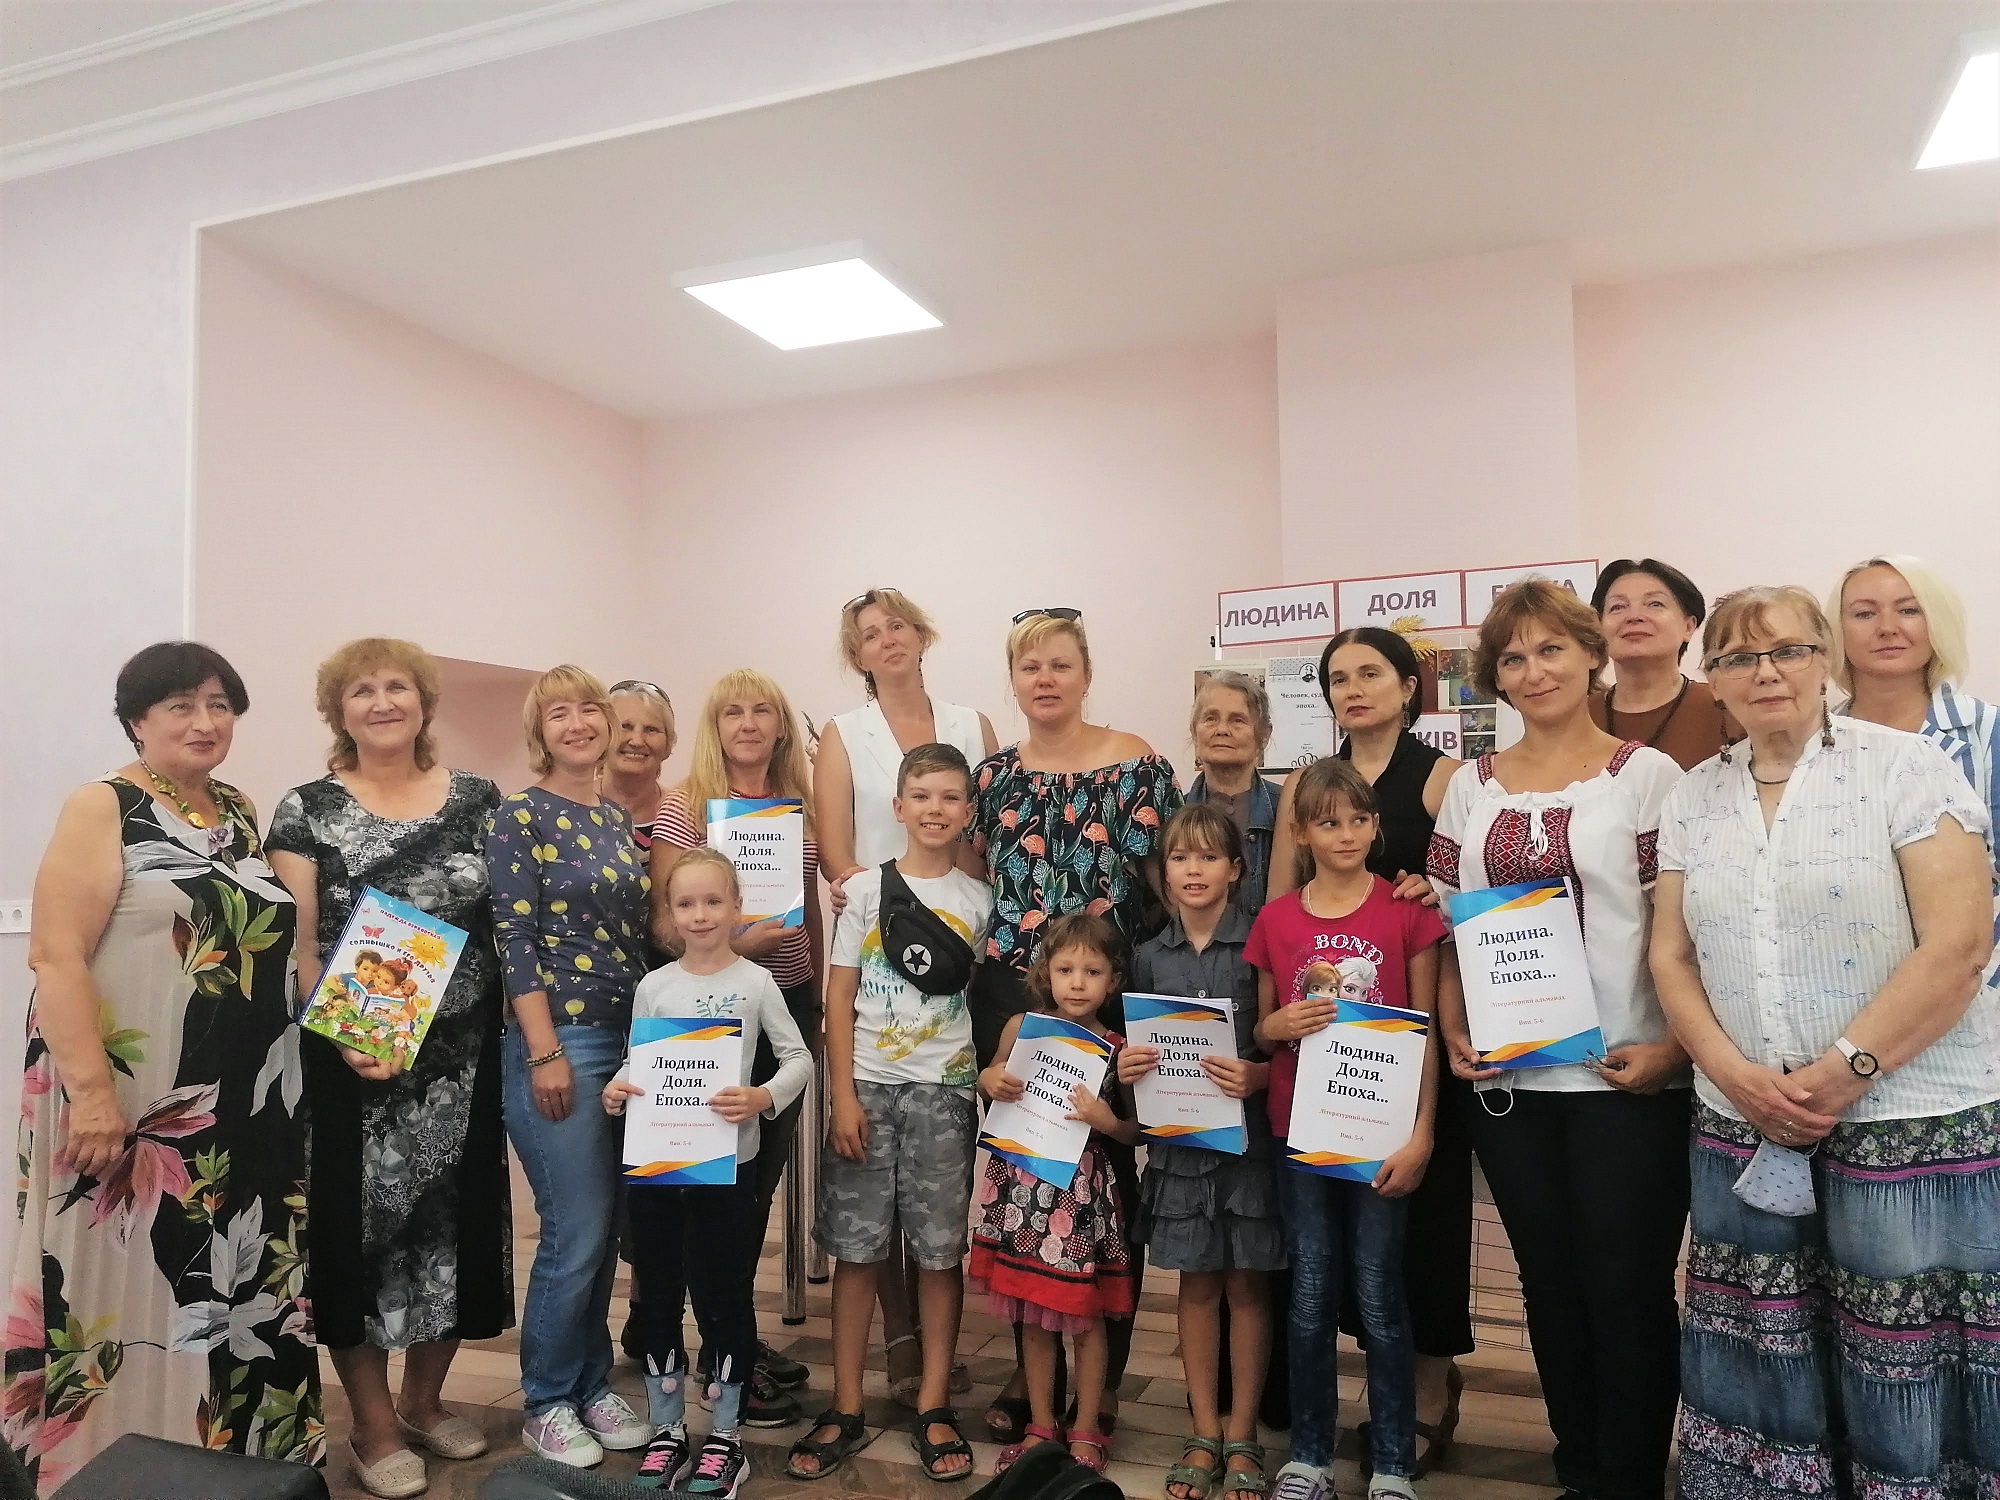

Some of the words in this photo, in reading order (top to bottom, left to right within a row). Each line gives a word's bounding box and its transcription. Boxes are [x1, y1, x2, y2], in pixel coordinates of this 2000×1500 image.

[1367, 589, 1437, 617] ДОЛЯ
[1224, 601, 1330, 629] ЛЮДИНА
[728, 830, 785, 843] Людина.
[738, 845, 776, 858] Доля.
[733, 860, 781, 871] Епоха...
[1478, 926, 1554, 947] Людина.
[1494, 948, 1544, 967] Доля.
[1489, 968, 1556, 985] Епоха...
[1148, 1032, 1214, 1047] Людина.
[1162, 1048, 1205, 1062] Доля.
[1326, 1040, 1399, 1066] Людина.
[651, 1056, 719, 1072] Людина.
[1031, 1050, 1087, 1082] Людина.
[1335, 1061, 1384, 1082] Доля.
[662, 1075, 707, 1090] Доля.
[1034, 1067, 1073, 1093] Доля.
[1025, 1080, 1073, 1111] Епоха...
[1326, 1079, 1389, 1103] Епоха...
